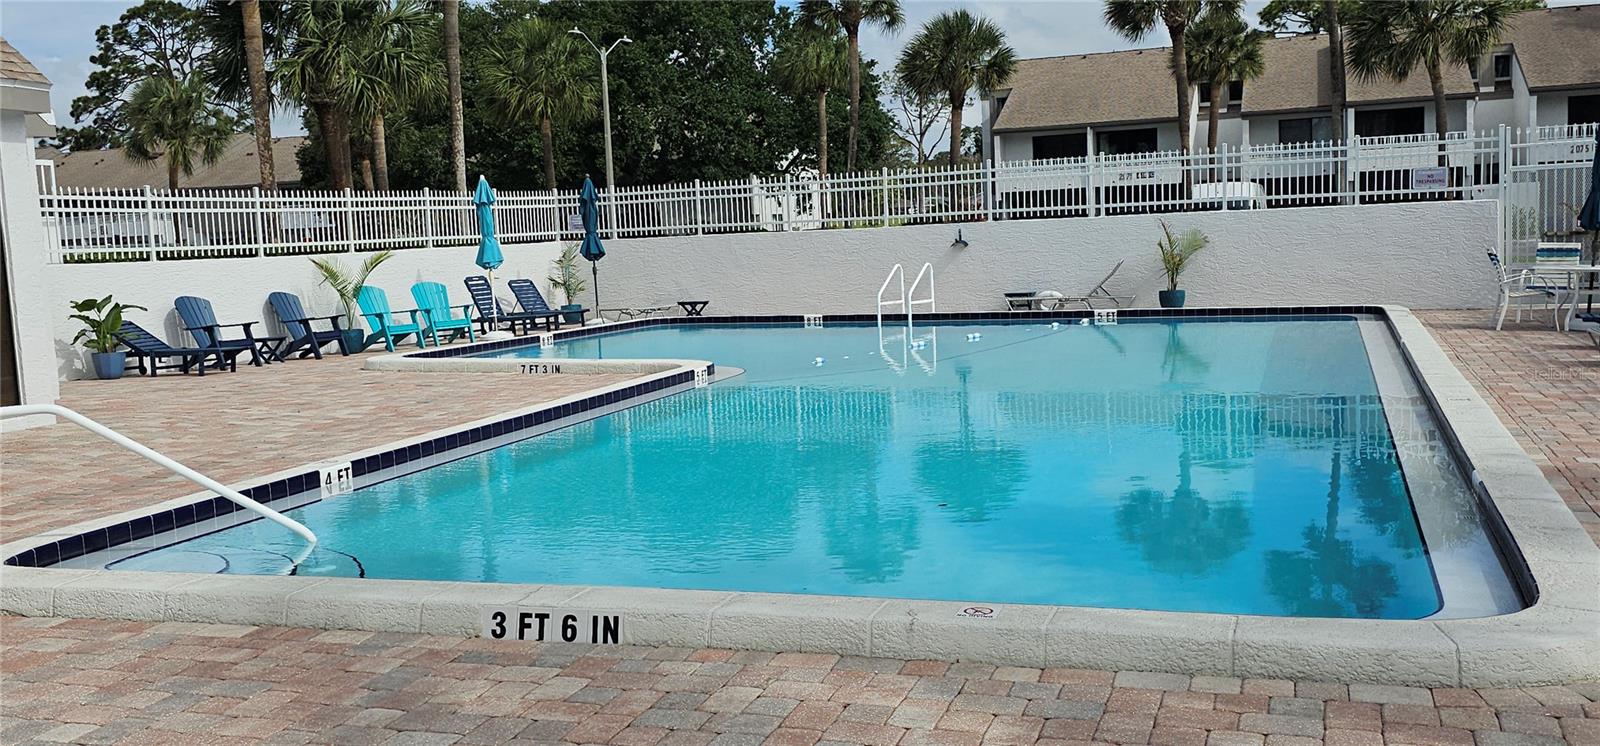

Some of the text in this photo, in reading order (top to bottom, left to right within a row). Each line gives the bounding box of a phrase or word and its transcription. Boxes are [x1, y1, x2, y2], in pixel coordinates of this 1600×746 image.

[1570, 144, 1590, 154] 2075
[520, 364, 526, 374] 7
[529, 364, 539, 374] FT
[542, 364, 548, 374] 3
[325, 466, 350, 485] 4 FT
[491, 611, 620, 644] 3 FT 6 IN
